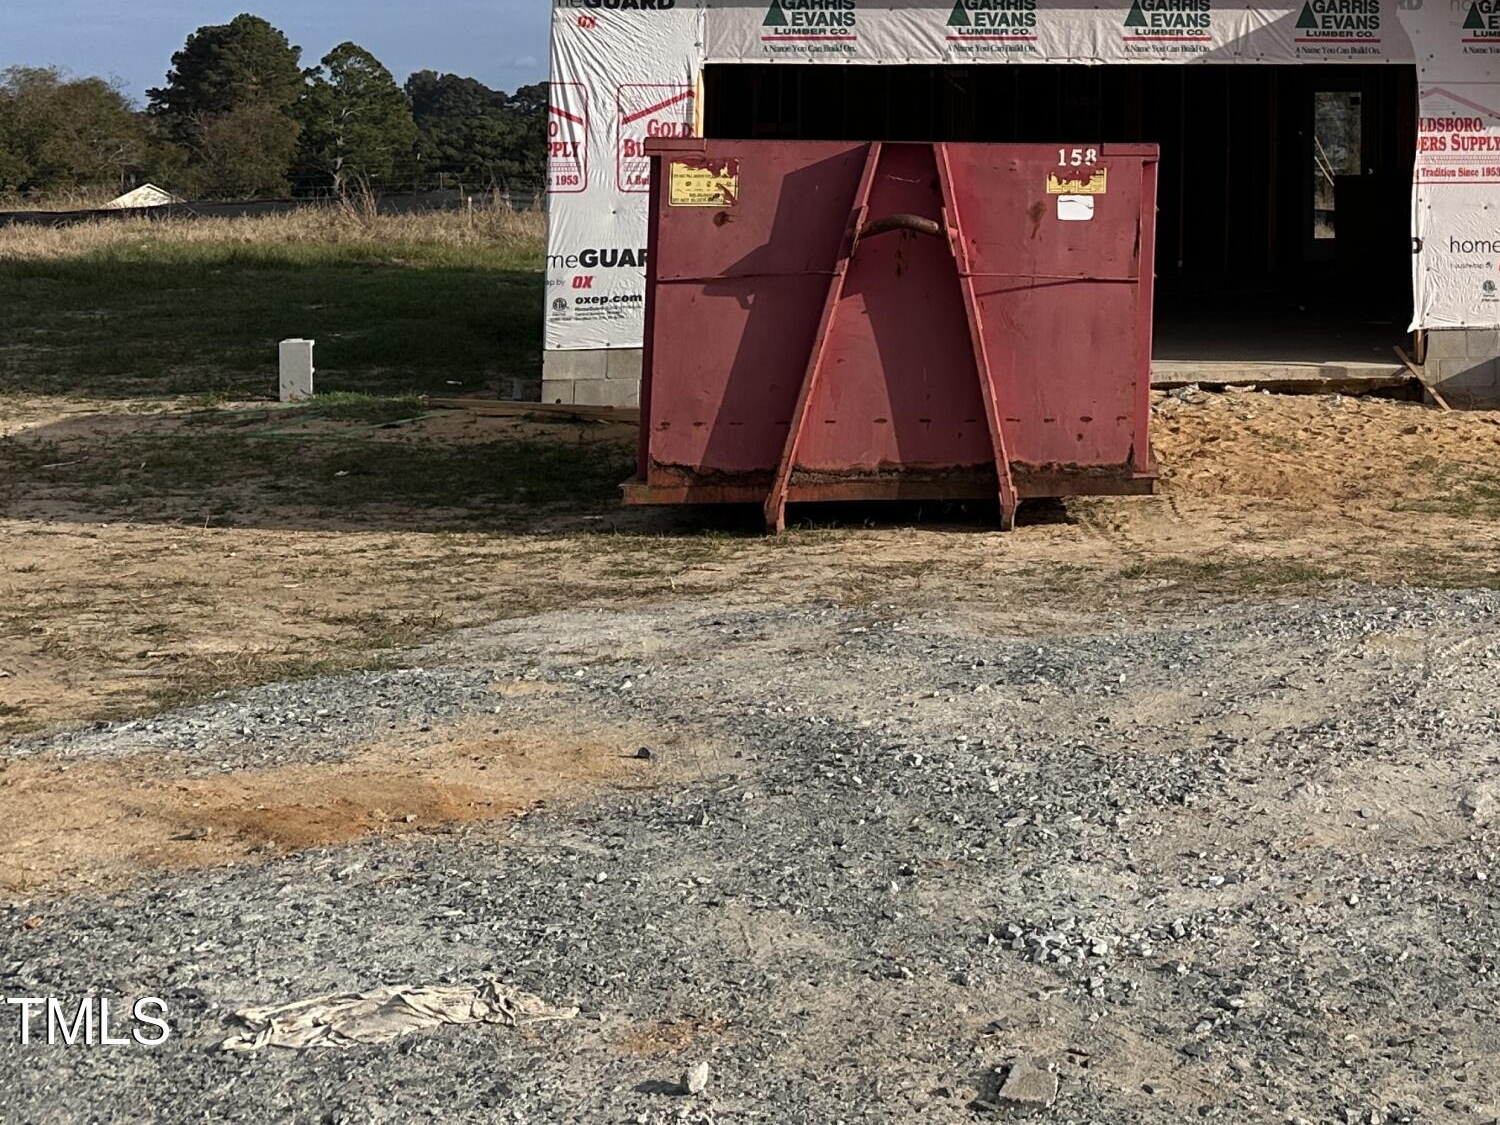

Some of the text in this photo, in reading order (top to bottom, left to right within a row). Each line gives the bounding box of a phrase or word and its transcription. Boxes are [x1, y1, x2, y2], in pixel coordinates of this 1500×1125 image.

[1313, 0, 1380, 14] GARRIS
[791, 11, 856, 26] EVANS
[974, 12, 1037, 29] EVANS
[1151, 13, 1211, 28] EVANS
[1322, 15, 1381, 30] EVANS
[774, 27, 828, 35] LUMBER
[958, 27, 1010, 35] LUMBER
[1058, 148, 1097, 166] 158
[1421, 167, 1500, 177] Tradition Since 1953
[555, 175, 578, 185] 1953
[572, 275, 593, 289] OX
[575, 294, 642, 305] oxep.com
